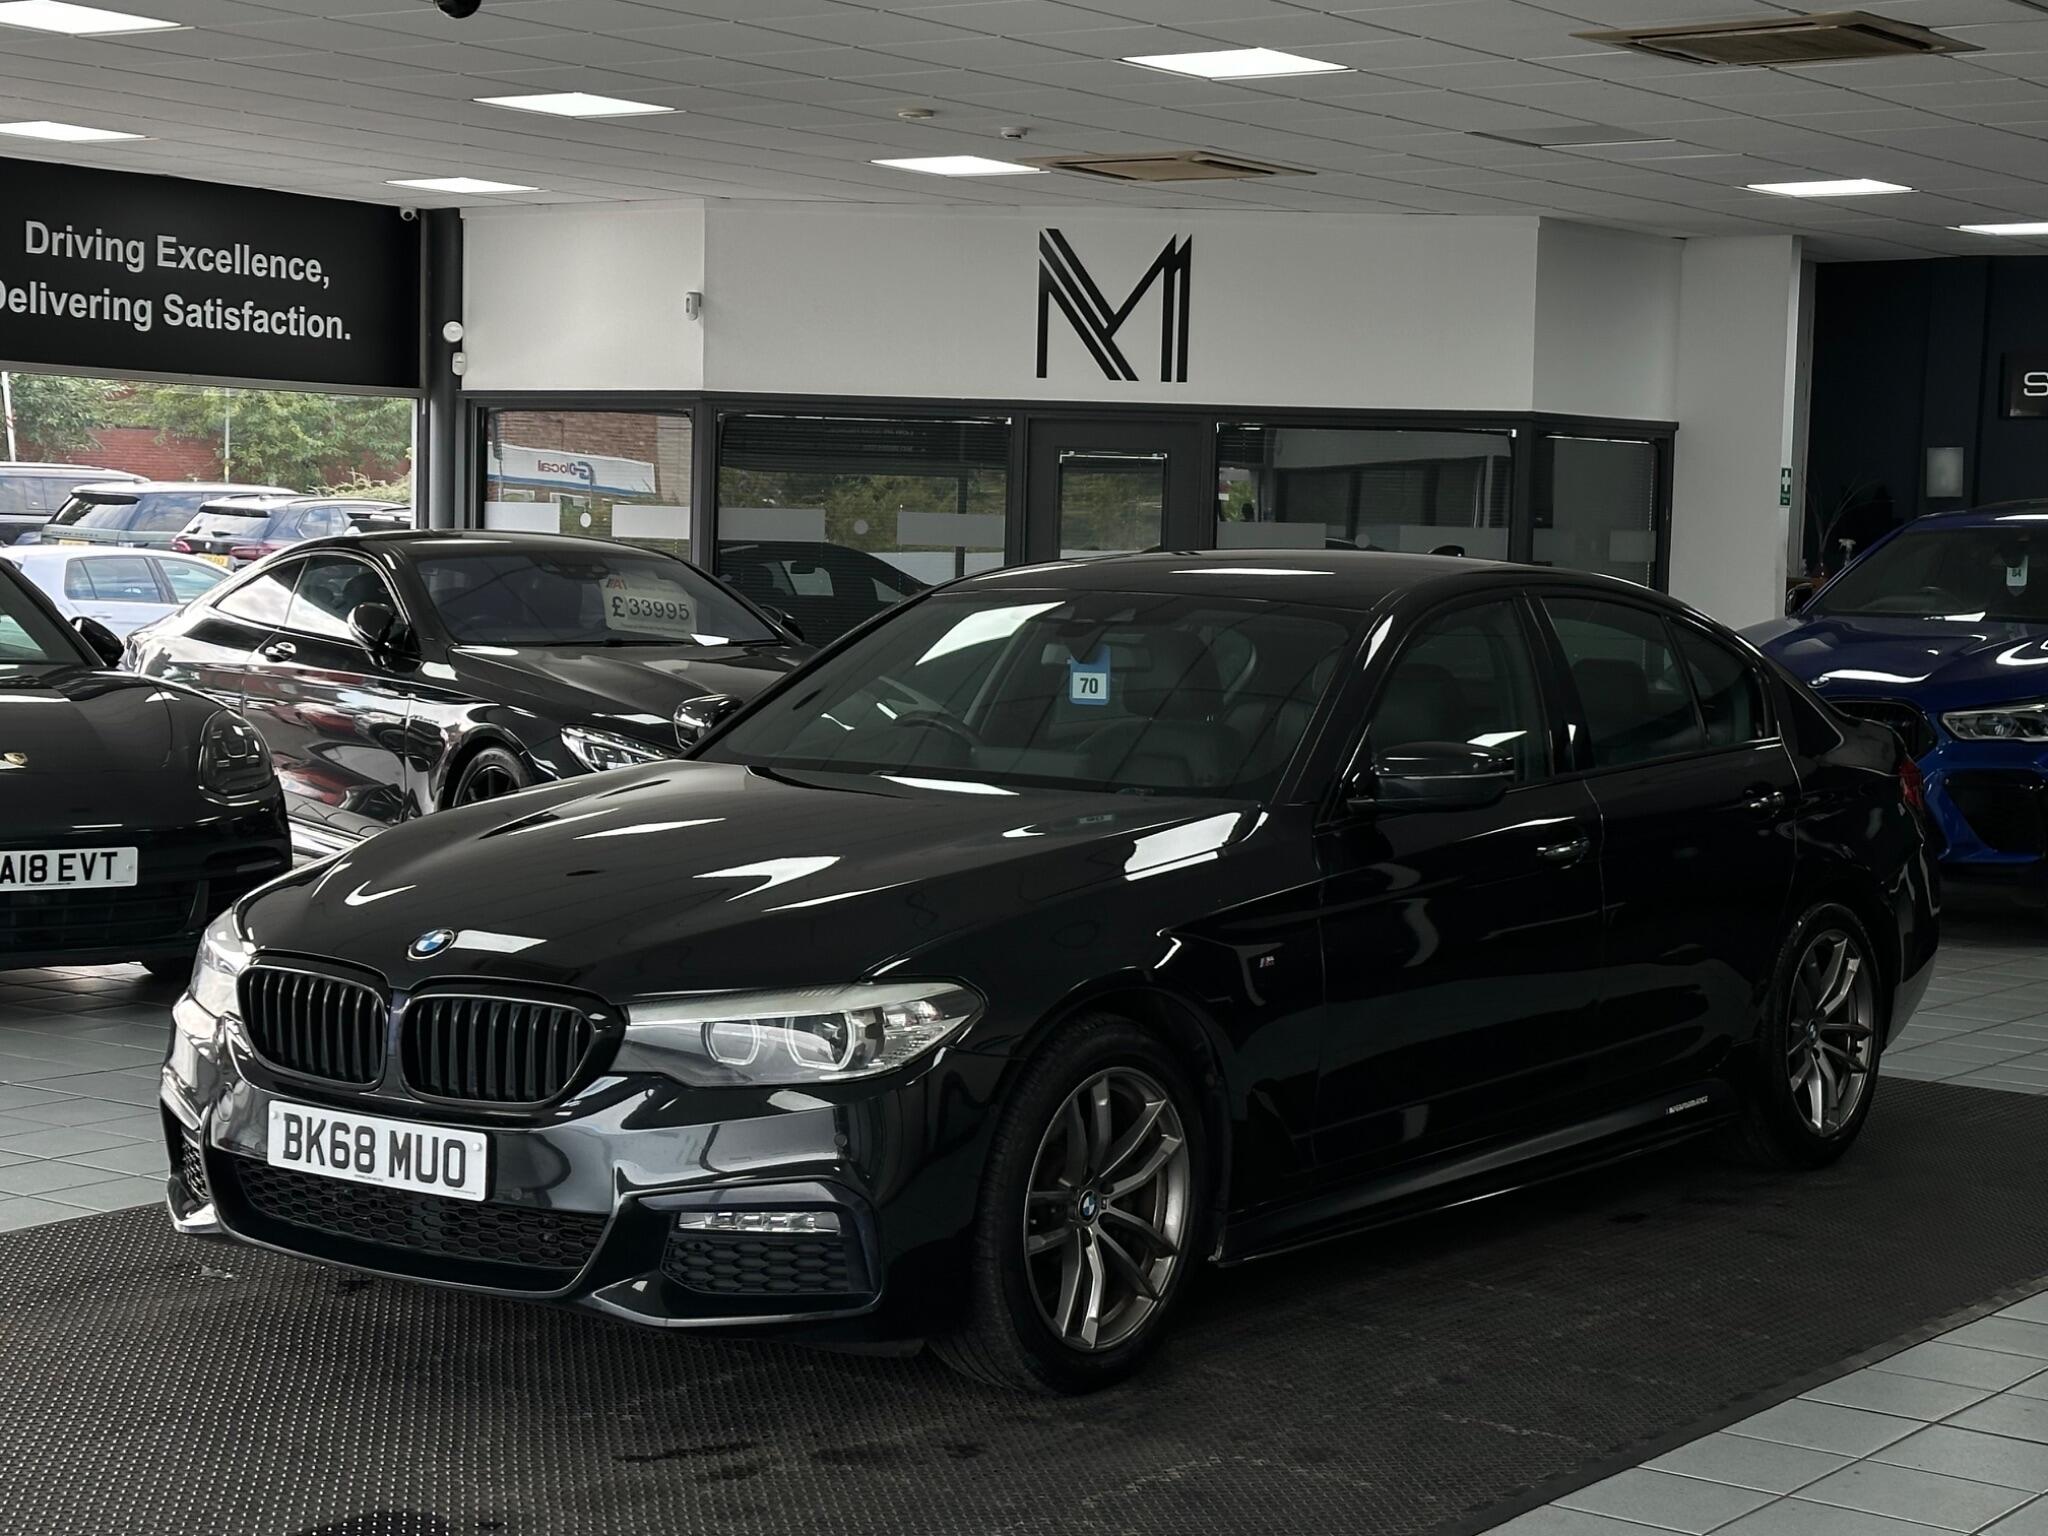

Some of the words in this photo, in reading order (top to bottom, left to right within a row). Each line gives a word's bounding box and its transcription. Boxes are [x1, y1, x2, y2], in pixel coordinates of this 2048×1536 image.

[25, 220, 145, 273] Driving
[156, 234, 330, 289] Excellence,
[163, 293, 352, 340] Satisfaction.
[1080, 678, 1098, 693] 70
[58, 851, 118, 882] EVT
[283, 1112, 376, 1174] BK68
[388, 1130, 466, 1188] MUO
